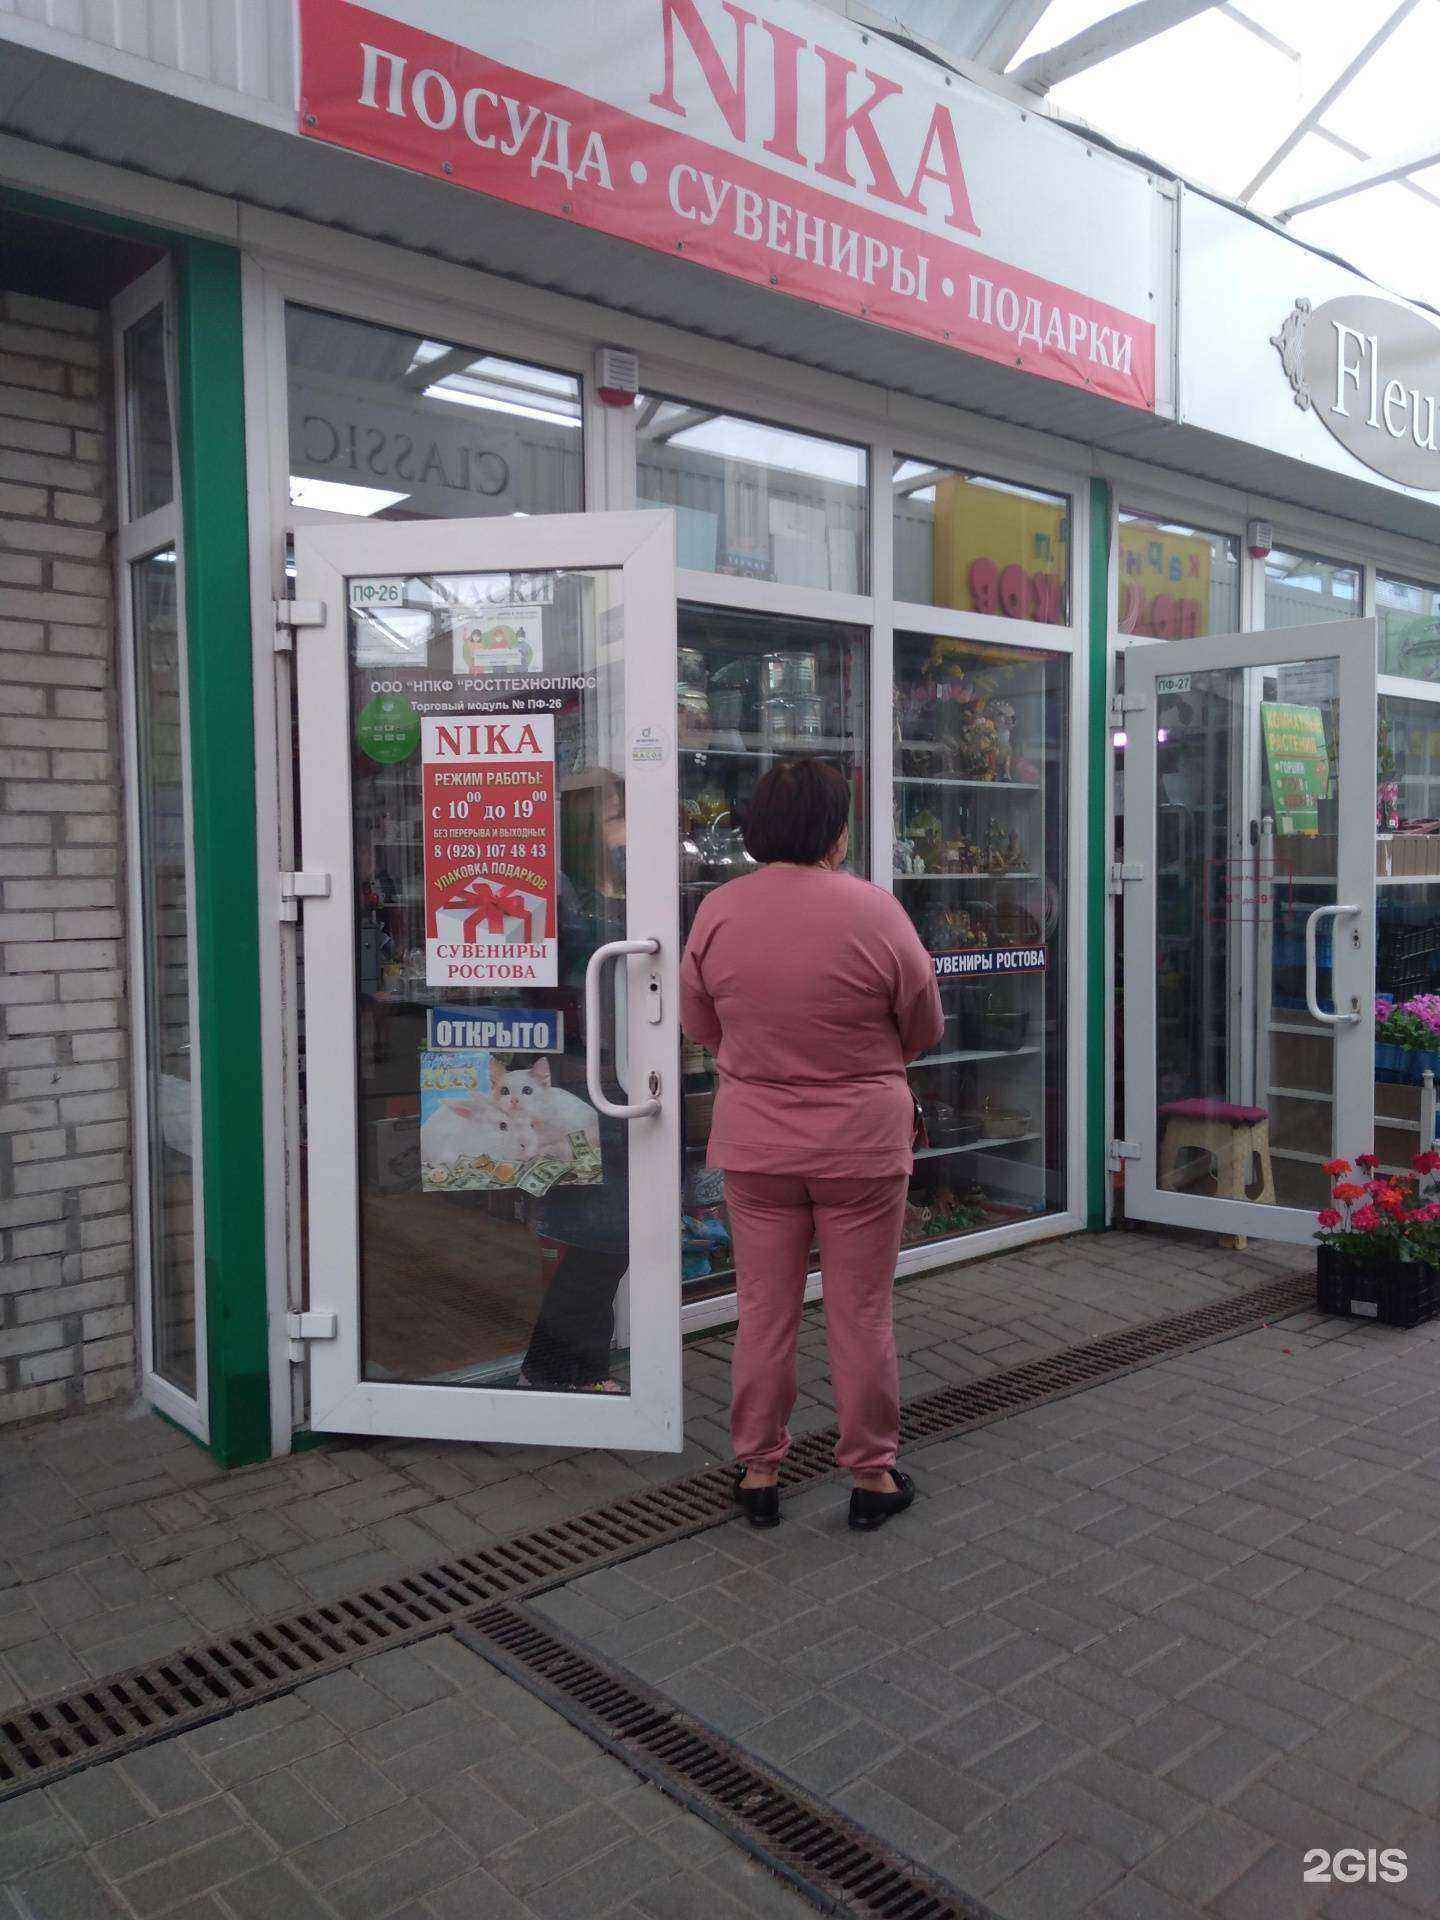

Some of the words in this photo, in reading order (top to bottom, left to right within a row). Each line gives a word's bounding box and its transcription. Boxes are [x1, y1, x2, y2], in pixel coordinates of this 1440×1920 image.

[650, 0, 981, 237] NIKA
[357, 43, 614, 191] ПОСУДА
[667, 164, 929, 304] СУВЕНИРЫ
[968, 276, 1134, 376] ПОДАРКИ
[353, 584, 399, 601] ПФ-26
[371, 681, 402, 693] ООО
[1158, 677, 1191, 691] ПФ-27
[411, 701, 464, 712] Торговый
[467, 701, 509, 712] модуль
[512, 700, 525, 709] №
[527, 699, 562, 709] ПФ-26
[435, 724, 542, 756] NIKA
[434, 773, 482, 786] РЕЖИМ
[486, 771, 543, 785] РАБОТЫ:
[484, 805, 506, 820] до
[433, 829, 448, 838] БЕЗ
[449, 828, 490, 838] ПЕРЕРЫВА
[499, 827, 546, 838] ВЫХОДНЫХ
[434, 844, 441, 858] 8
[447, 844, 480, 860] (928)
[486, 844, 506, 858] 107
[510, 844, 526, 858] 48
[530, 843, 546, 858] 43
[434, 862, 489, 892] УПАКОВКА
[491, 862, 548, 890] ПОДАРКОВ
[436, 944, 547, 959] СУВЕНИРЫ
[932, 953, 992, 975] УВЕНИРЫ
[996, 950, 1045, 969] РОСТОВА
[448, 964, 536, 979] РОСТОВА
[437, 1021, 549, 1048] ОТКРЫТО
